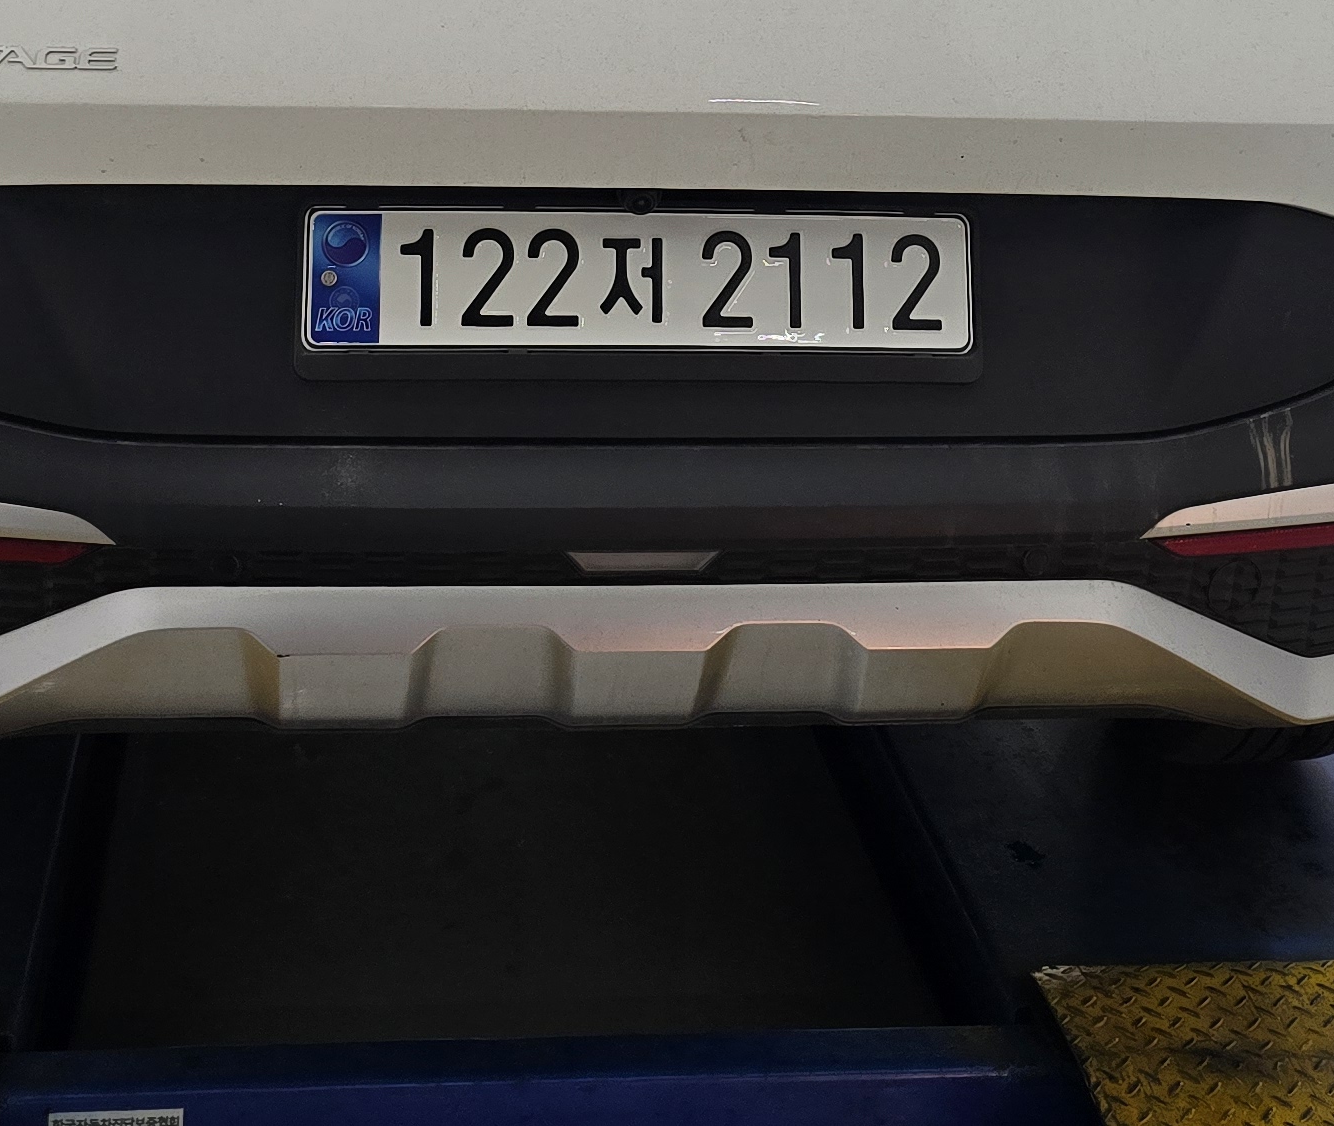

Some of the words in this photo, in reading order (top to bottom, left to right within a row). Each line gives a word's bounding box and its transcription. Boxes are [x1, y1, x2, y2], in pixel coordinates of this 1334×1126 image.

[399, 228, 663, 328] 122저
[702, 231, 942, 331] 2112
[315, 307, 372, 332] KOR
